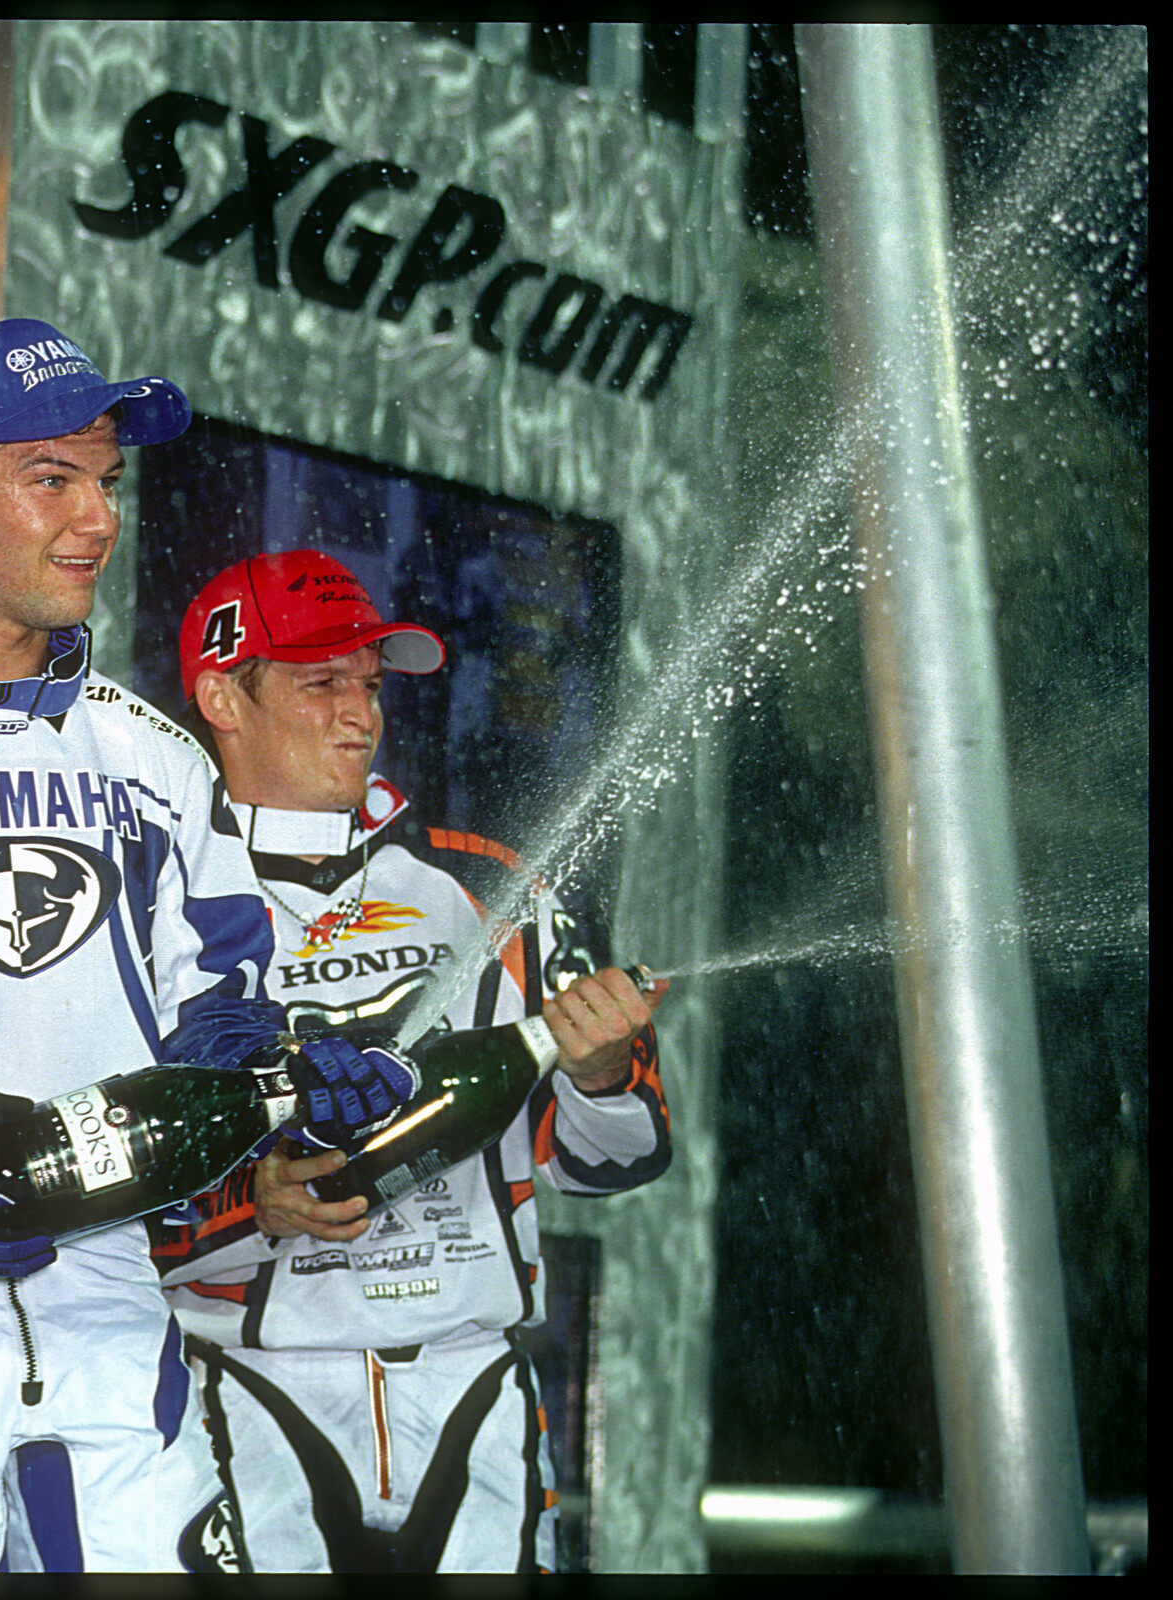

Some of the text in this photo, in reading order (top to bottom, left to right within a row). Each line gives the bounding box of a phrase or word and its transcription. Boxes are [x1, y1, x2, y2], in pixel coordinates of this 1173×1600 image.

[73, 90, 693, 400] SXGP.com
[200, 599, 245, 664] 4
[278, 943, 456, 988] HONDA
[67, 1091, 117, 1176] COOK'S
[353, 1243, 435, 1266] WHITE
